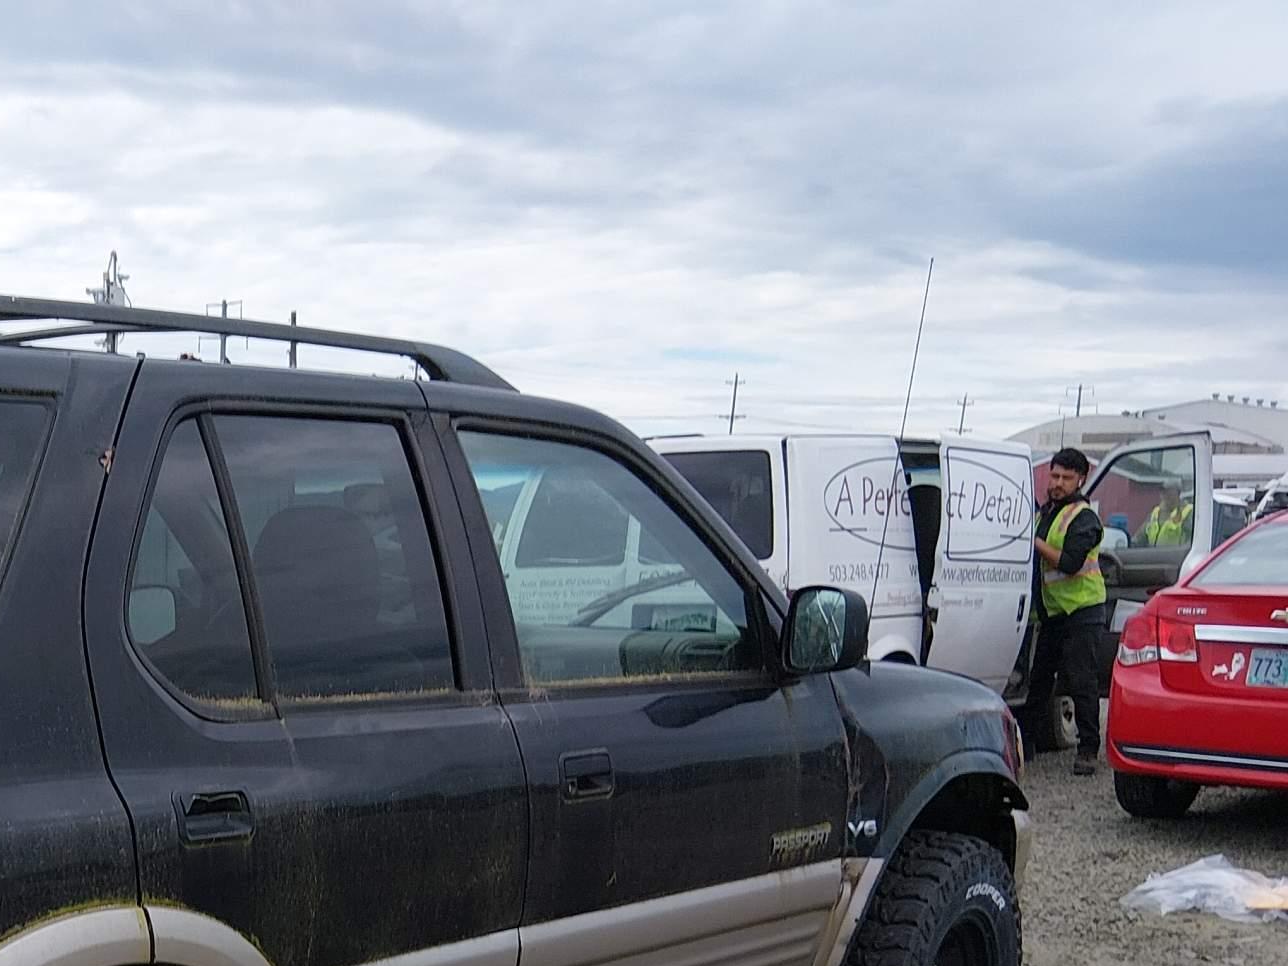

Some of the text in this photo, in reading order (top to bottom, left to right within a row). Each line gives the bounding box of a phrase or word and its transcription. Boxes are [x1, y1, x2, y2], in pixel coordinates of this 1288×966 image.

[834, 475, 854, 517] A
[970, 480, 1026, 528] Detail
[829, 563, 890, 583] 503.248.477
[772, 824, 831, 856] PASSPORT
[847, 819, 878, 838] V6
[966, 882, 1006, 912] COOPER
